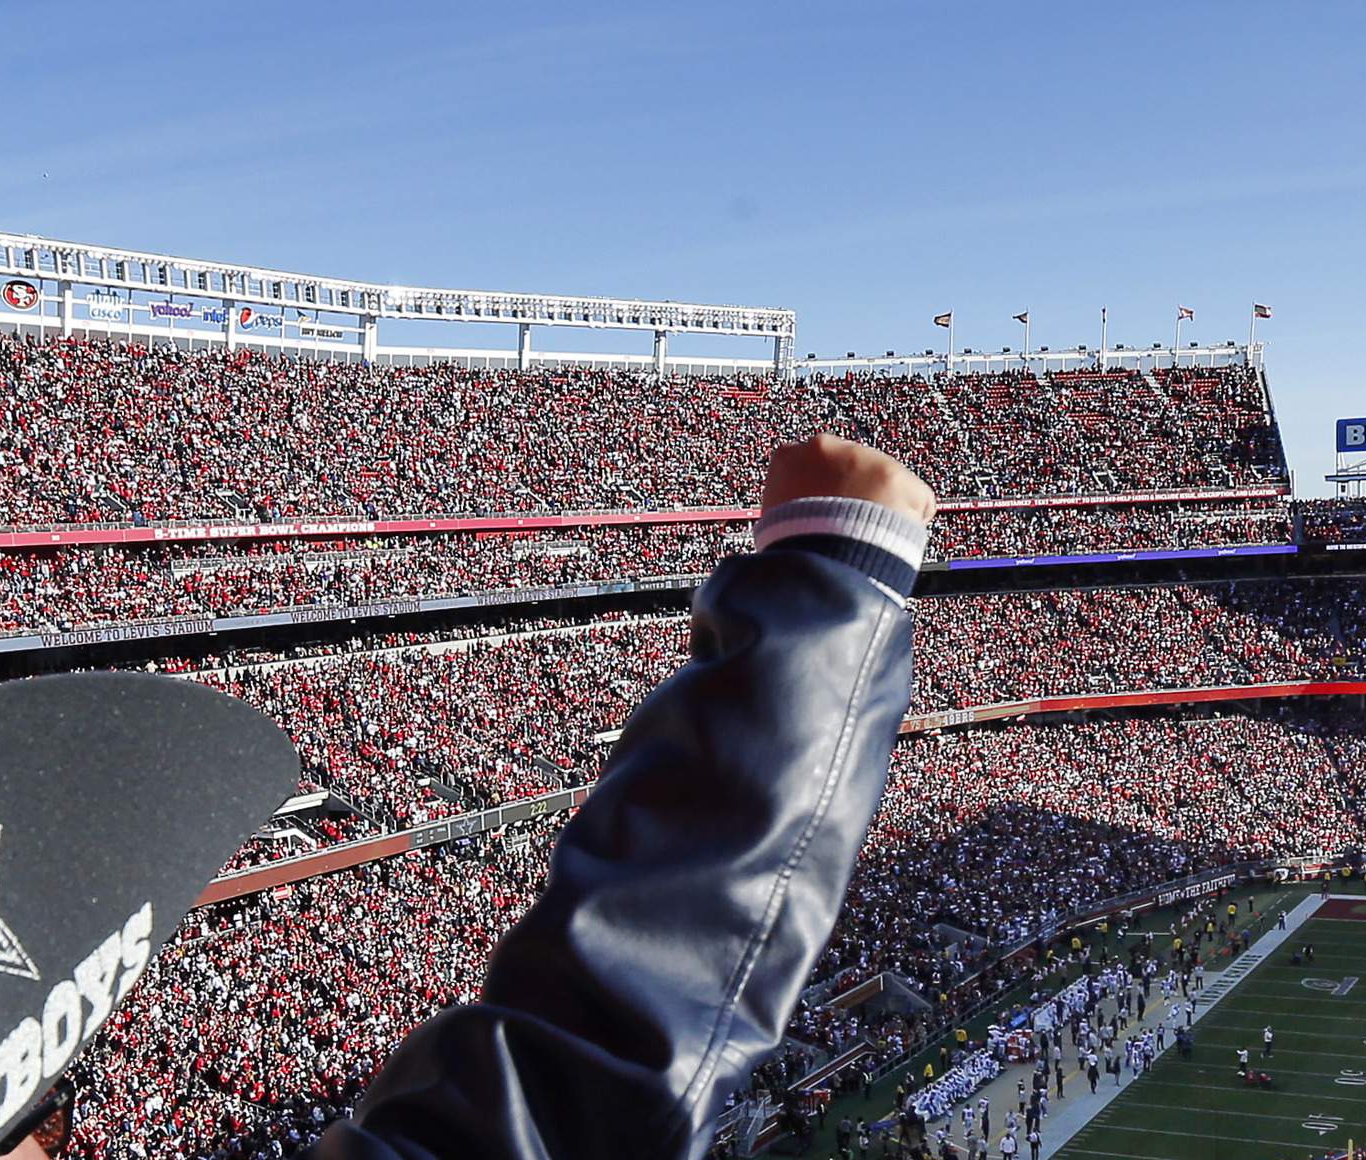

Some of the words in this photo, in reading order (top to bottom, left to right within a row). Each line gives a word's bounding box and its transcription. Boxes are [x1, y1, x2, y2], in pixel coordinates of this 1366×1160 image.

[209, 525, 257, 537] SUPER
[259, 524, 298, 536] BOWL
[301, 522, 376, 535] CHAMPIONS
[290, 609, 335, 624] WELCOME
[337, 608, 350, 620] TO
[351, 605, 381, 618] LEVI'S
[383, 602, 422, 616] STADIUM
[40, 629, 100, 648] WELCOME
[102, 628, 120, 643] TO
[122, 624, 161, 641] LEVI'S
[164, 620, 215, 637] STADIUM
